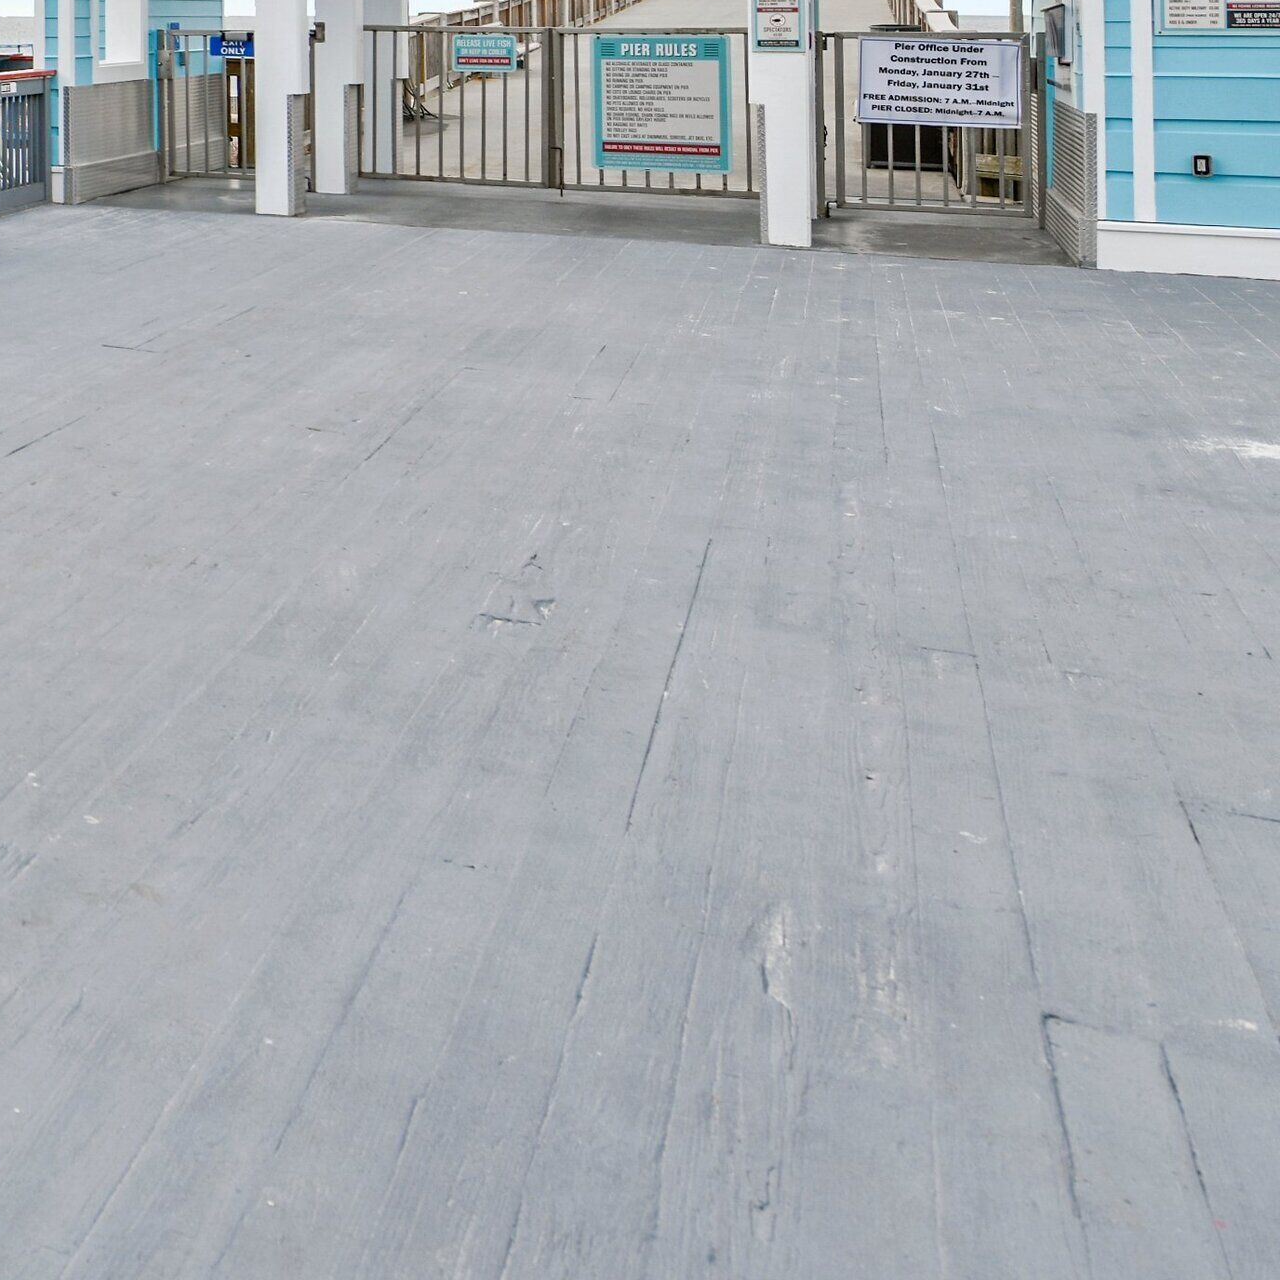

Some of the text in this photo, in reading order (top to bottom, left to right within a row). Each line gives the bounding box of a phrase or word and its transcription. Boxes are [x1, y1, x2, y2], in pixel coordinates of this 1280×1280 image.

[457, 39, 481, 47] RELEASE
[894, 42, 984, 53] Pier Office Under
[220, 47, 246, 55] ONLY
[621, 43, 697, 57] PIER RULES
[890, 55, 987, 66] Construction From
[878, 67, 990, 79] Monday, January 27th
[887, 80, 989, 92] Friday, January 31st
[863, 93, 886, 101] FREE
[888, 94, 942, 104] ADMISSION:
[894, 105, 932, 114] CLOSED:
